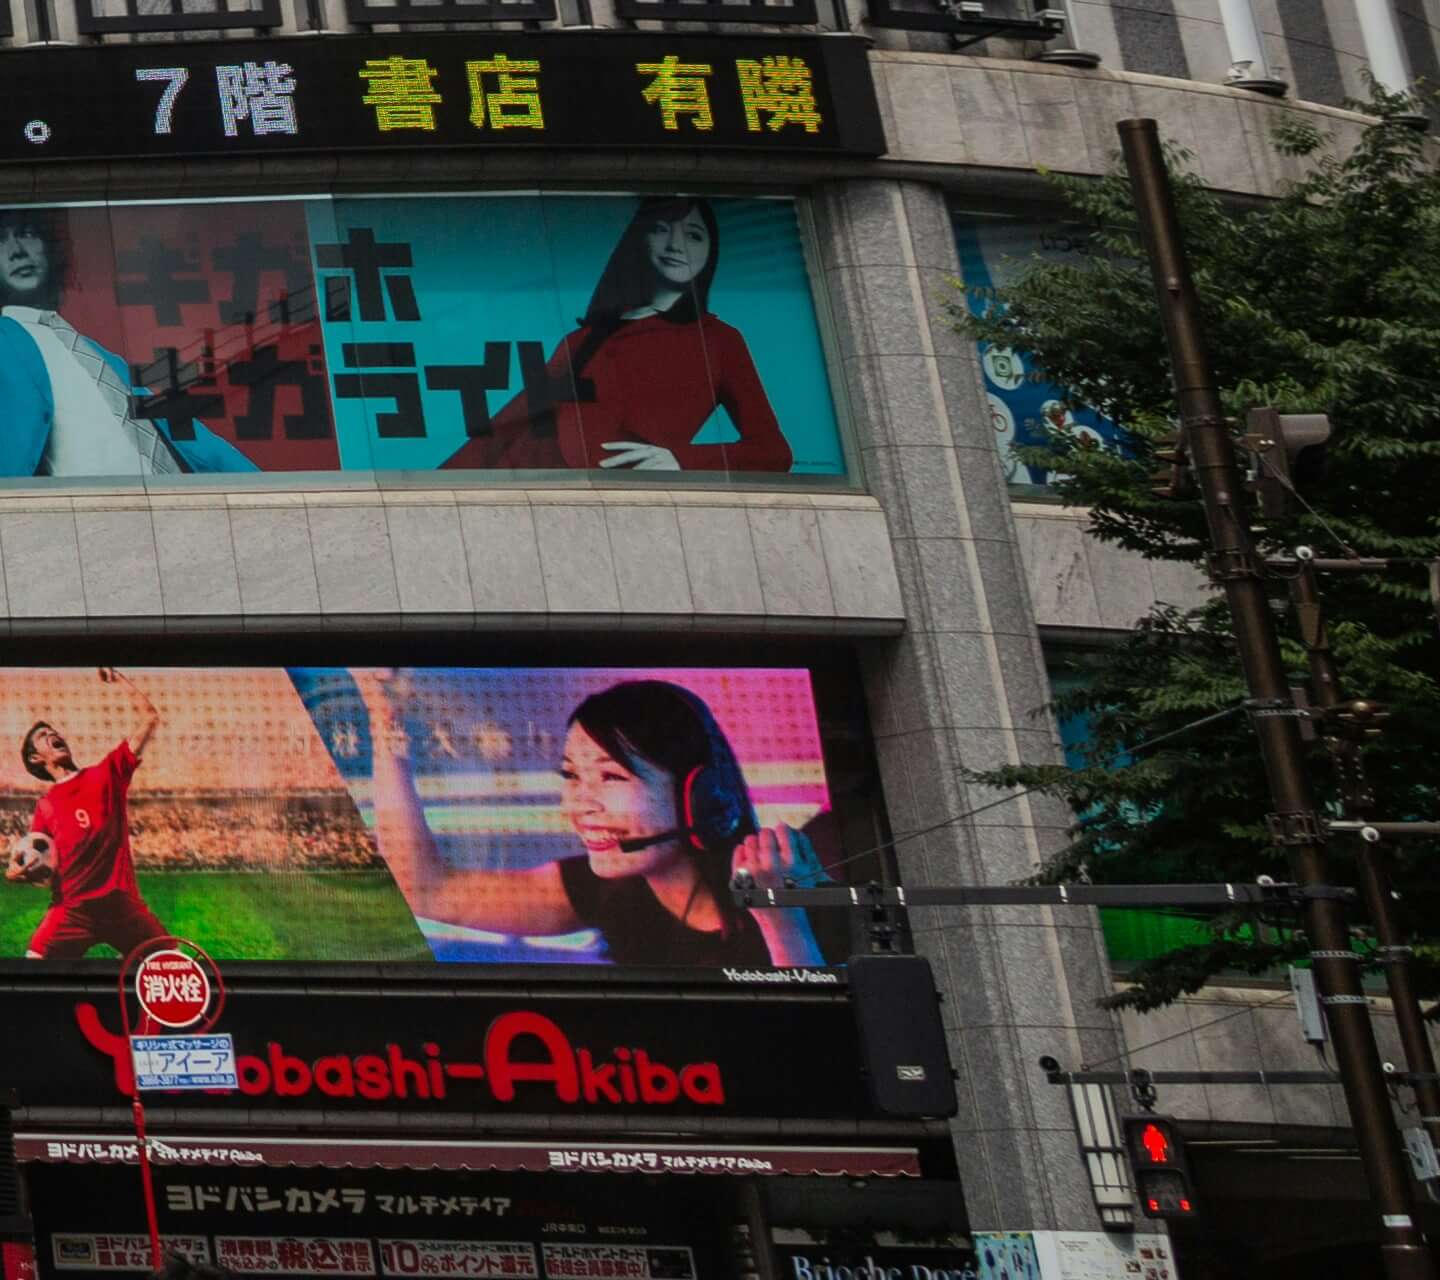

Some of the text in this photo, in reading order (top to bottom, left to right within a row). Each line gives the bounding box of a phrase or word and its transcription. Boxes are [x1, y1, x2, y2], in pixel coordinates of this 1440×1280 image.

[135, 61, 300, 136] 7階
[358, 52, 546, 134] 書店
[636, 54, 822, 133] 有隣
[116, 226, 422, 327] ギガホ
[130, 339, 598, 442] ギガライト
[142, 973, 204, 1003] 消火栓
[723, 966, 837, 983] Yodobashi-Vision
[157, 1051, 230, 1073] アイーア
[548, 1150, 658, 1168] ヨドバシカメラ
[165, 1183, 512, 1217] ヨドバシカメラ マルチメディア
